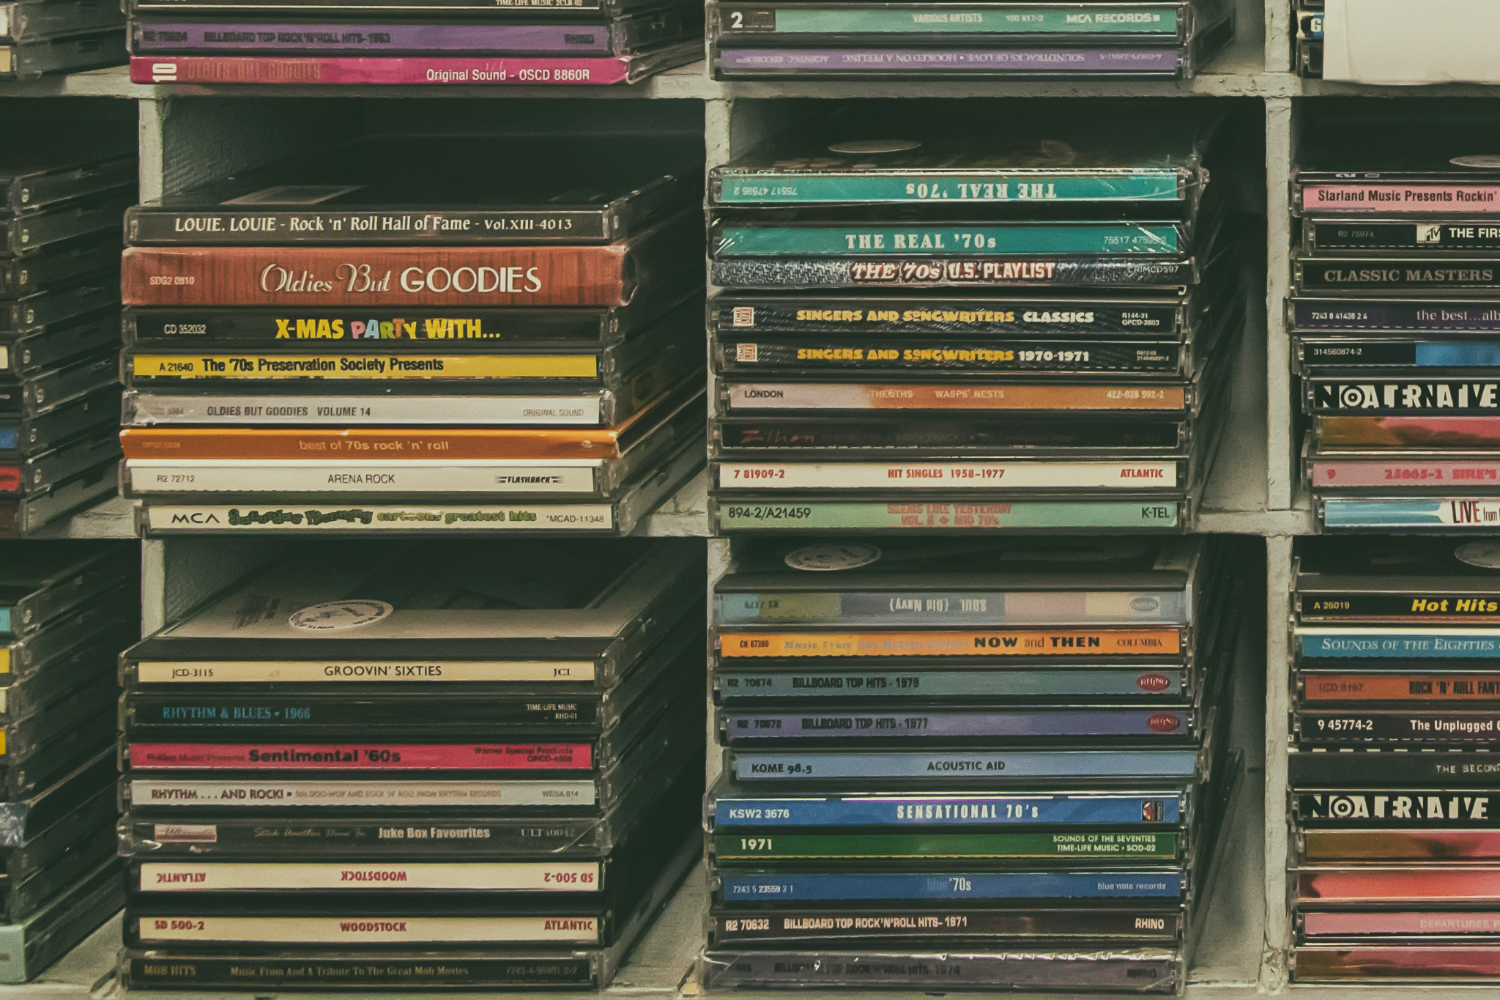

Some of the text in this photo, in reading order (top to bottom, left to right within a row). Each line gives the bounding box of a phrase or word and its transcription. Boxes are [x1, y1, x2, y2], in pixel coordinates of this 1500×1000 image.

[427, 68, 506, 82] Original Sound
[1449, 228, 1474, 238] THE
[846, 234, 996, 249] THE REAL '70s
[260, 263, 541, 294] Oldies But GOODIES
[276, 318, 500, 339] X-MAS PARTY WITH...
[328, 474, 363, 483] ARENA
[366, 474, 395, 483] ROCK
[888, 469, 1163, 478] HIT SINGLES 1958-1977 ATLANTIC
[1412, 600, 1448, 611] Hot
[1456, 599, 1497, 611] Hits
[325, 666, 569, 677] GROOVIN' SIXTIES JCI
[1318, 720, 1324, 730] 9
[1328, 720, 1372, 730] 45774-2
[1410, 721, 1430, 731] The
[1434, 721, 1493, 733] Unplugged
[898, 805, 1038, 819] SENSATIONAL 70's
[741, 839, 771, 850] 1971
